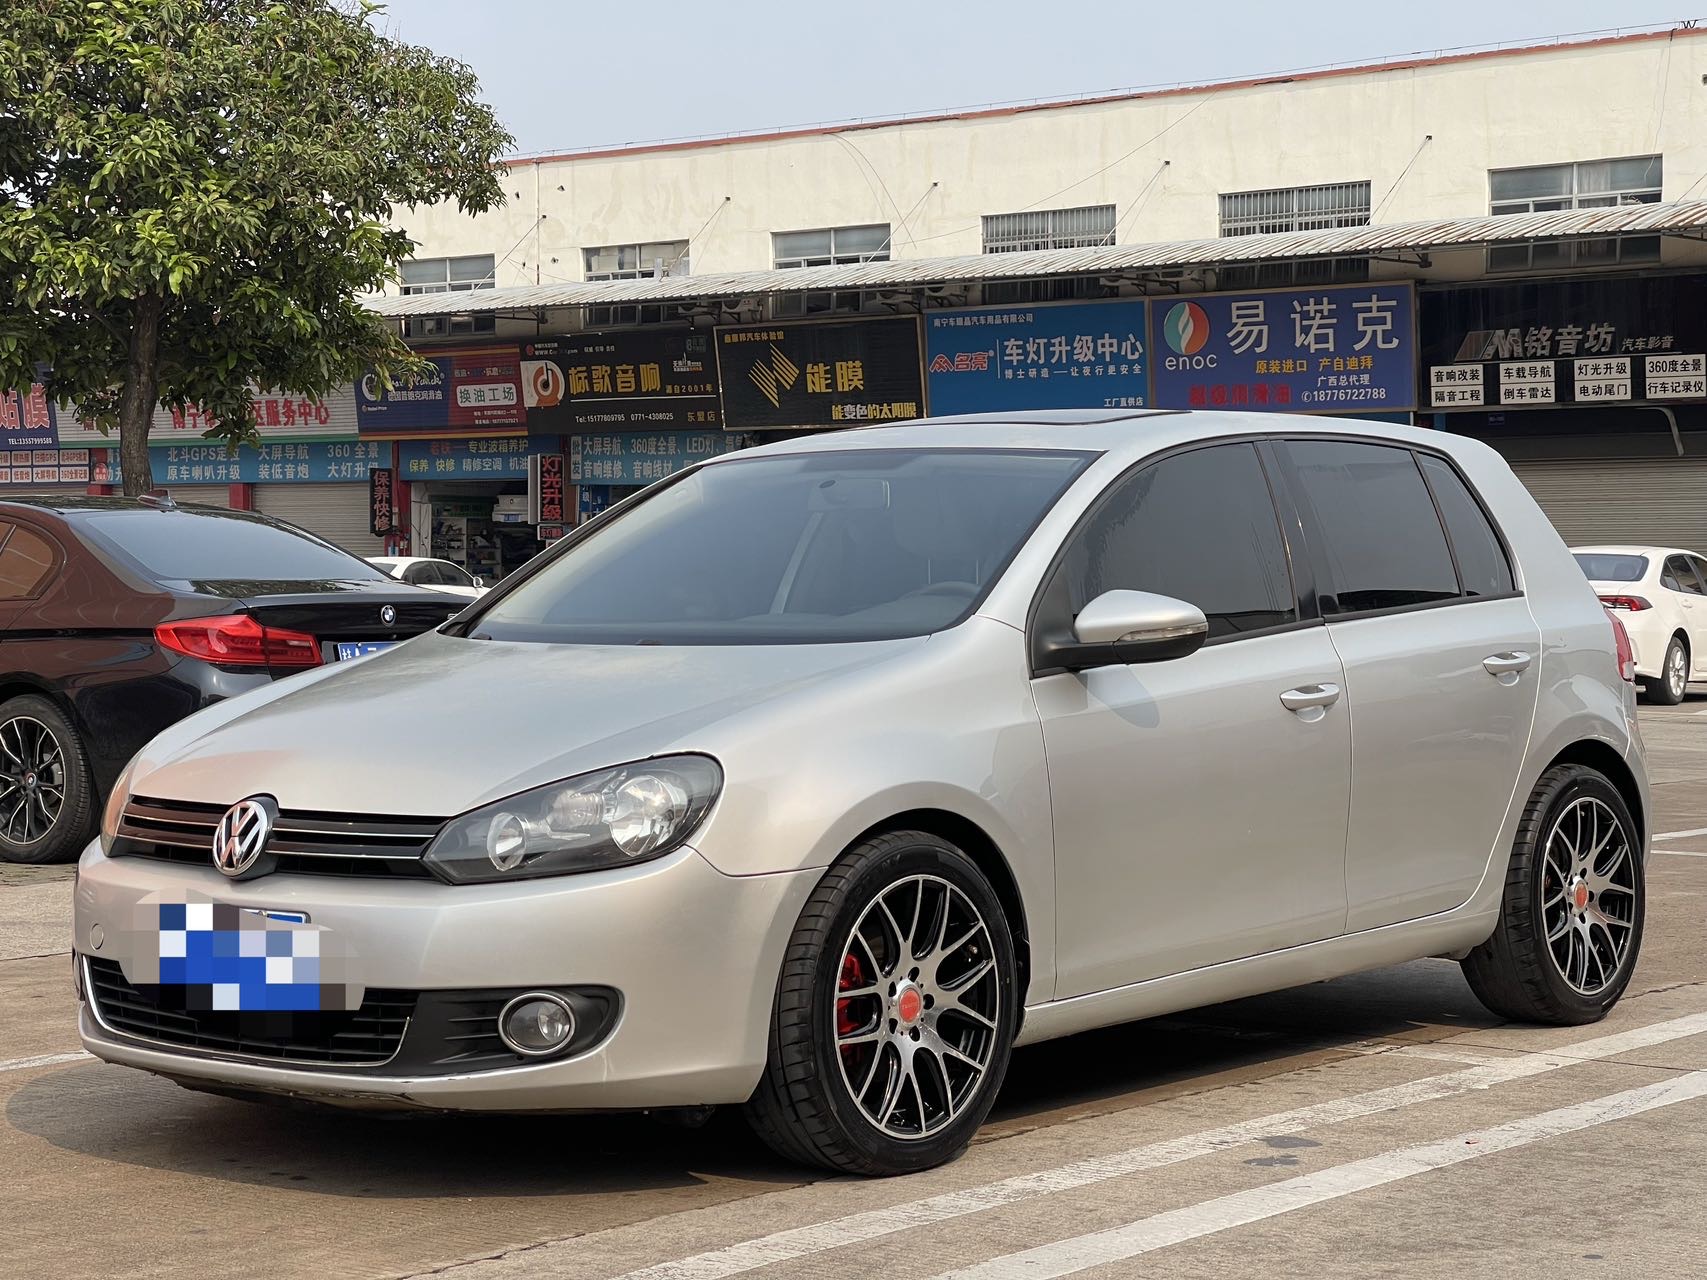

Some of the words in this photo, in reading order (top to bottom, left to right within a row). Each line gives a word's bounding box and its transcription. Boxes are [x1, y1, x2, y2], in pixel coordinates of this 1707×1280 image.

[1226, 294, 1400, 354] 易诺克
[1524, 322, 1616, 358] 铭音坊
[1621, 335, 1675, 351] 汽车影音
[1003, 332, 1144, 366] 车灯升级中心
[954, 352, 988, 371] 名亮
[1164, 354, 1218, 370] enoc
[1255, 359, 1308, 374] 原装进口
[1318, 355, 1374, 372] 产自迪拜
[1577, 361, 1628, 377] 灯光升级
[1648, 358, 1703, 374] 360度全景
[568, 362, 662, 395] 标歌音响
[805, 360, 864, 393] 能膜
[1317, 374, 1371, 387] 广西总代理
[1434, 368, 1481, 383] 音响改装
[1503, 365, 1552, 380] 车载导航
[459, 386, 515, 404] 换油工场
[1313, 388, 1386, 402] 18776722788
[1503, 386, 1552, 400] 倒车雷达
[1579, 383, 1628, 397] 电动尾门
[1647, 379, 1705, 394] 行车记录仪
[1104, 397, 1144, 407] 工厂直供店
[1434, 389, 1481, 403] 隔音工程
[0, 383, 50, 430] 贴膜
[831, 402, 917, 420] 能变色的太阳膜
[630, 412, 674, 422] 0771-4308025
[258, 444, 309, 461] 大屏导航
[167, 463, 241, 481] 原车喇叭升级
[258, 463, 309, 480] 装低音炮
[409, 459, 429, 473] 保养
[435, 457, 456, 472] 快修
[462, 457, 503, 472] 精修空调
[509, 456, 528, 470] 机油
[541, 455, 562, 521] 灯光升级
[373, 470, 390, 531] 保养快修
